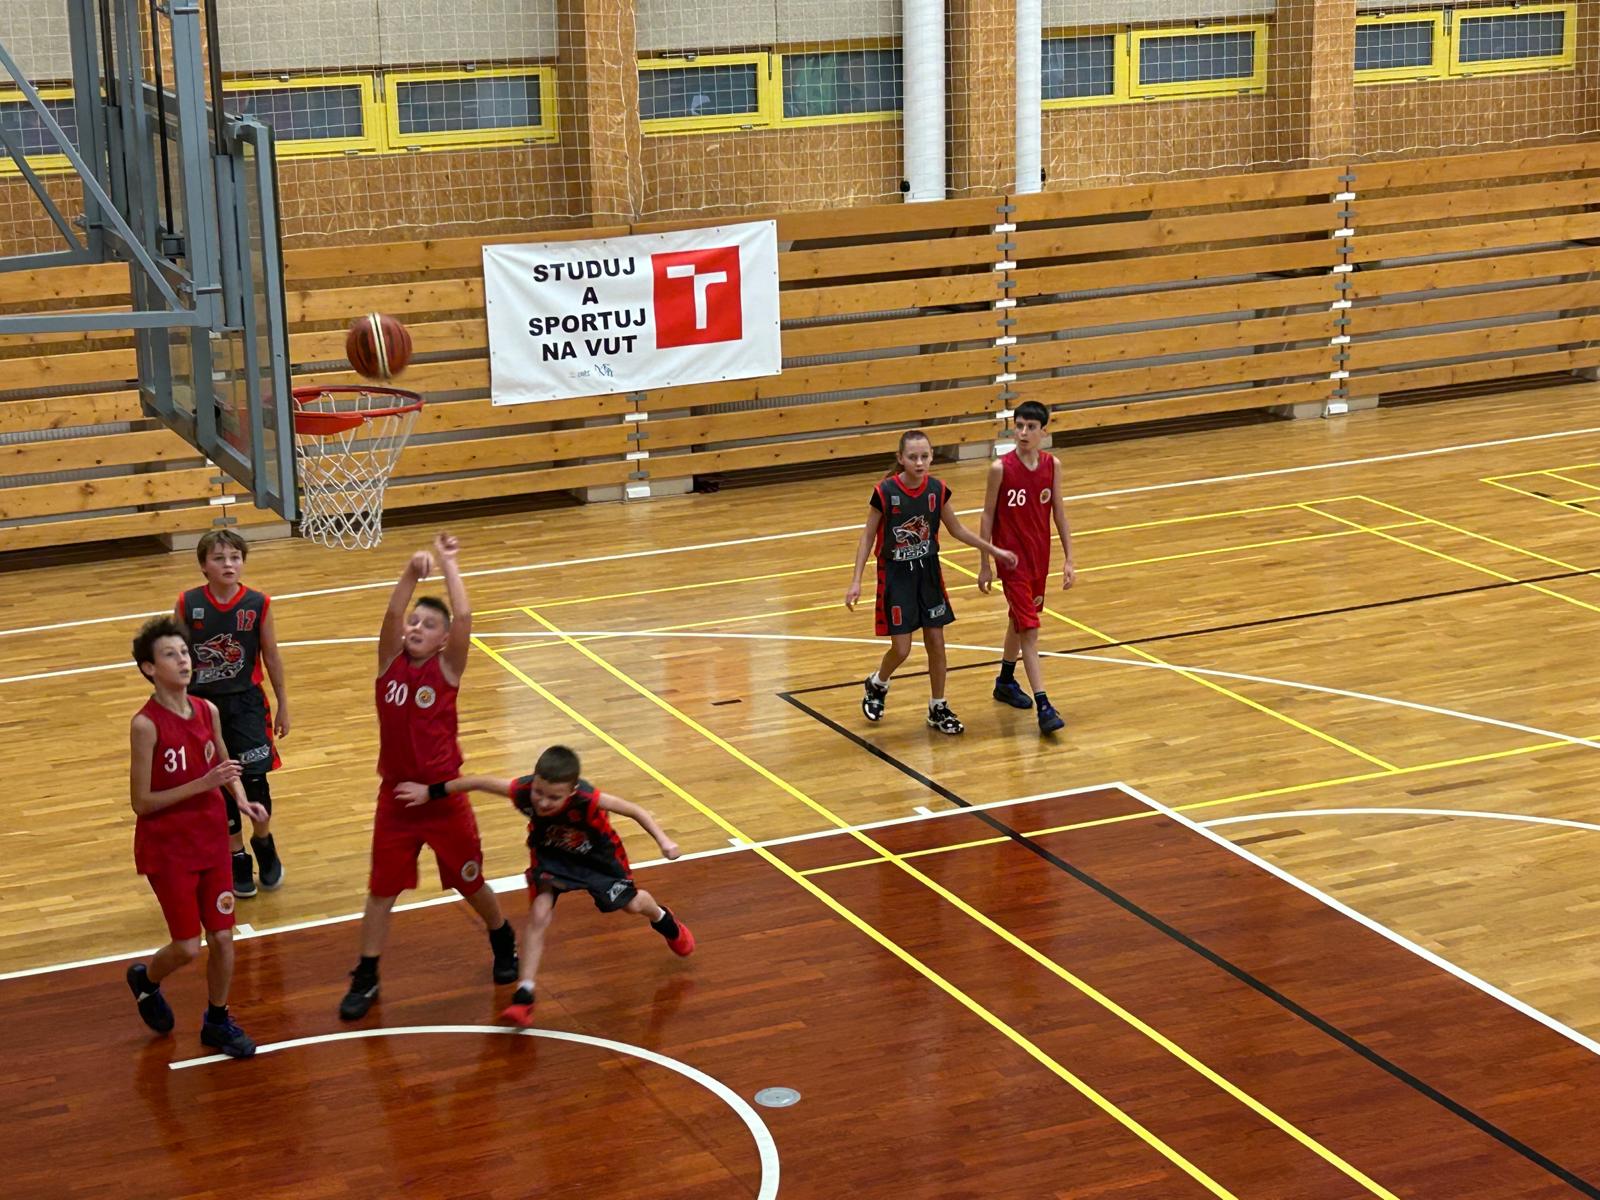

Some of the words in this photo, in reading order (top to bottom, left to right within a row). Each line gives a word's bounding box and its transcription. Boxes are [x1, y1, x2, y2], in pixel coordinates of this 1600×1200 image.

[533, 257, 636, 282] STUDUJ
[581, 286, 599, 306] A
[528, 308, 646, 336] SPORTUJ
[542, 340, 578, 362] NA
[584, 335, 638, 357] VUT
[1007, 488, 1027, 507] 26
[385, 680, 409, 707] 30
[164, 745, 187, 773] 31
